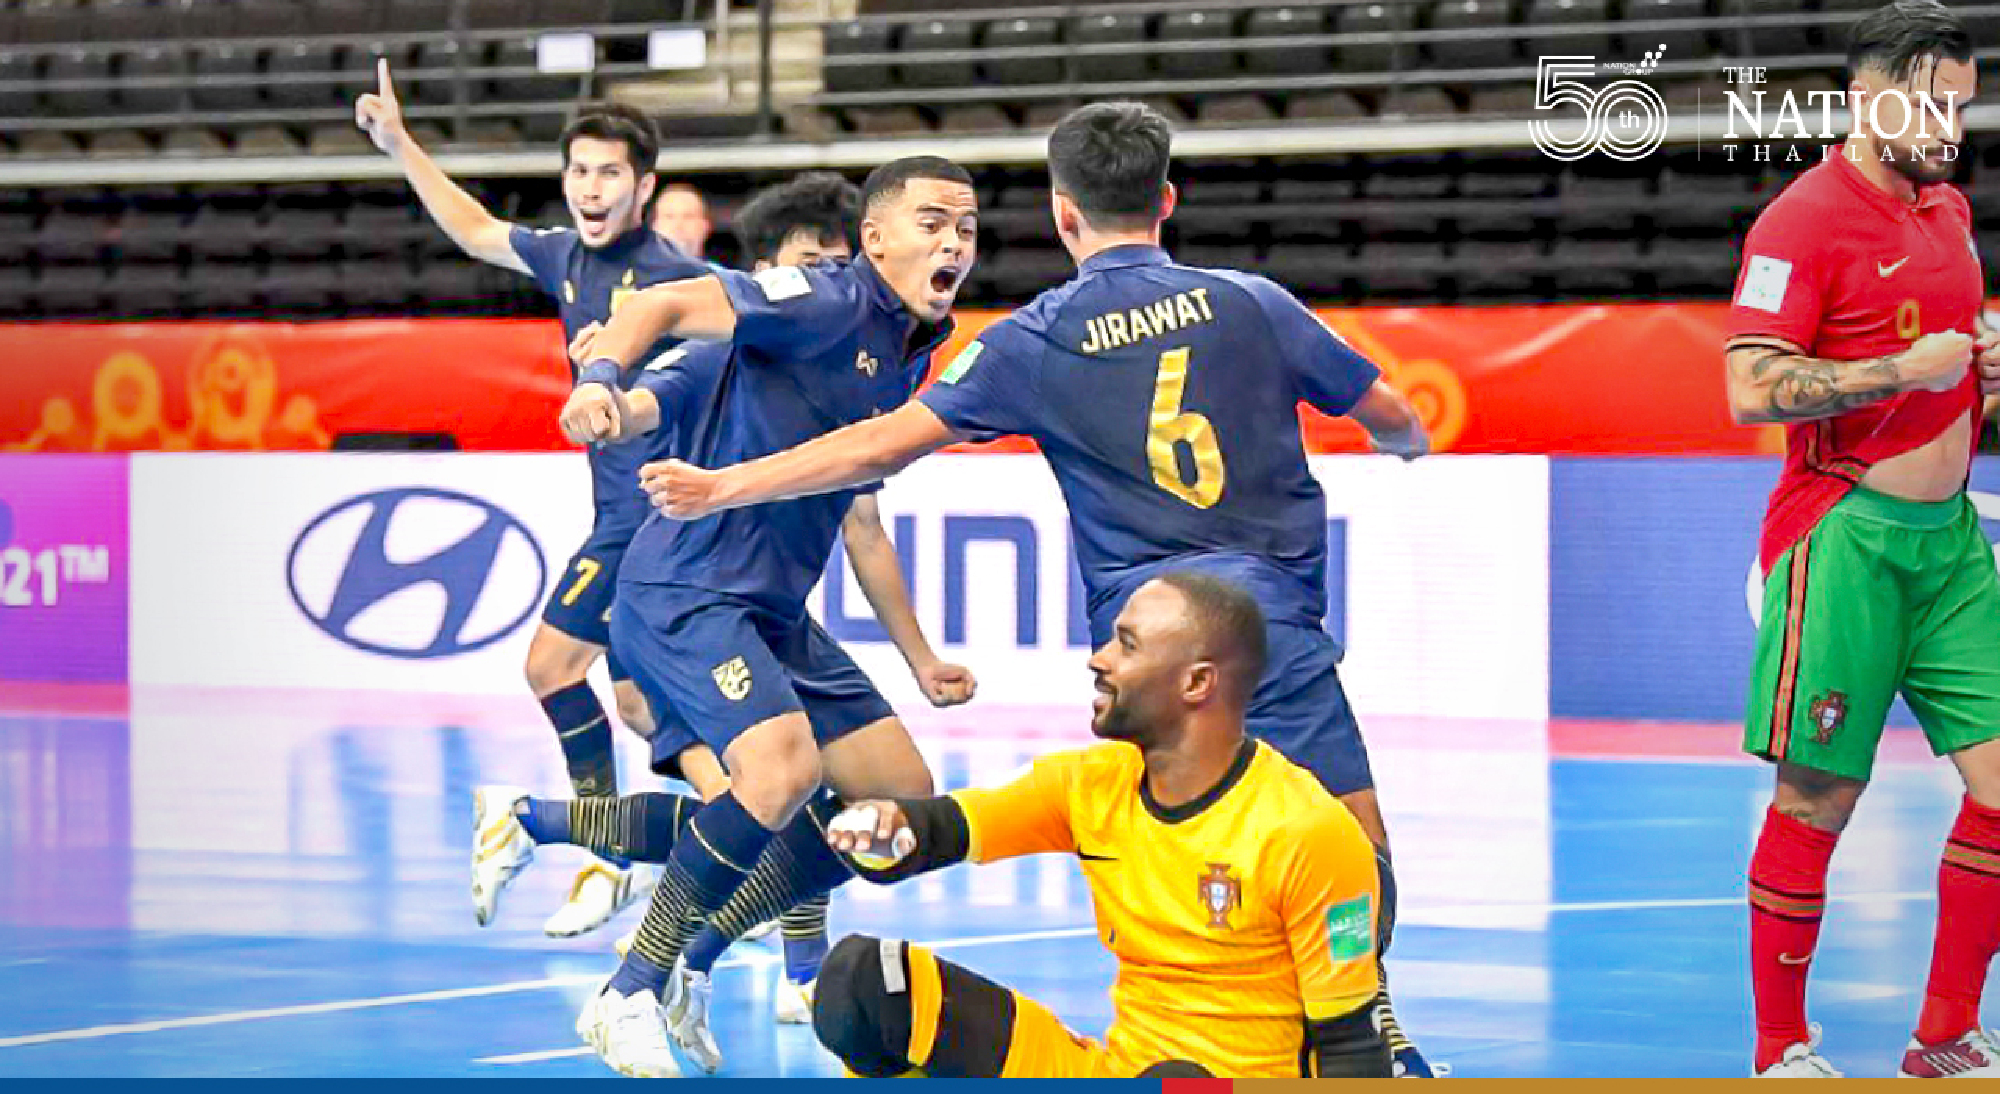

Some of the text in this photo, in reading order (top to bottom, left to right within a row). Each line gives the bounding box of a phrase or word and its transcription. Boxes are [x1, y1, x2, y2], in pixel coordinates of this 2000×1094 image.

[1080, 288, 1214, 353] JIRAWAT
[1147, 347, 1224, 510] 6
[561, 557, 601, 606] 7
